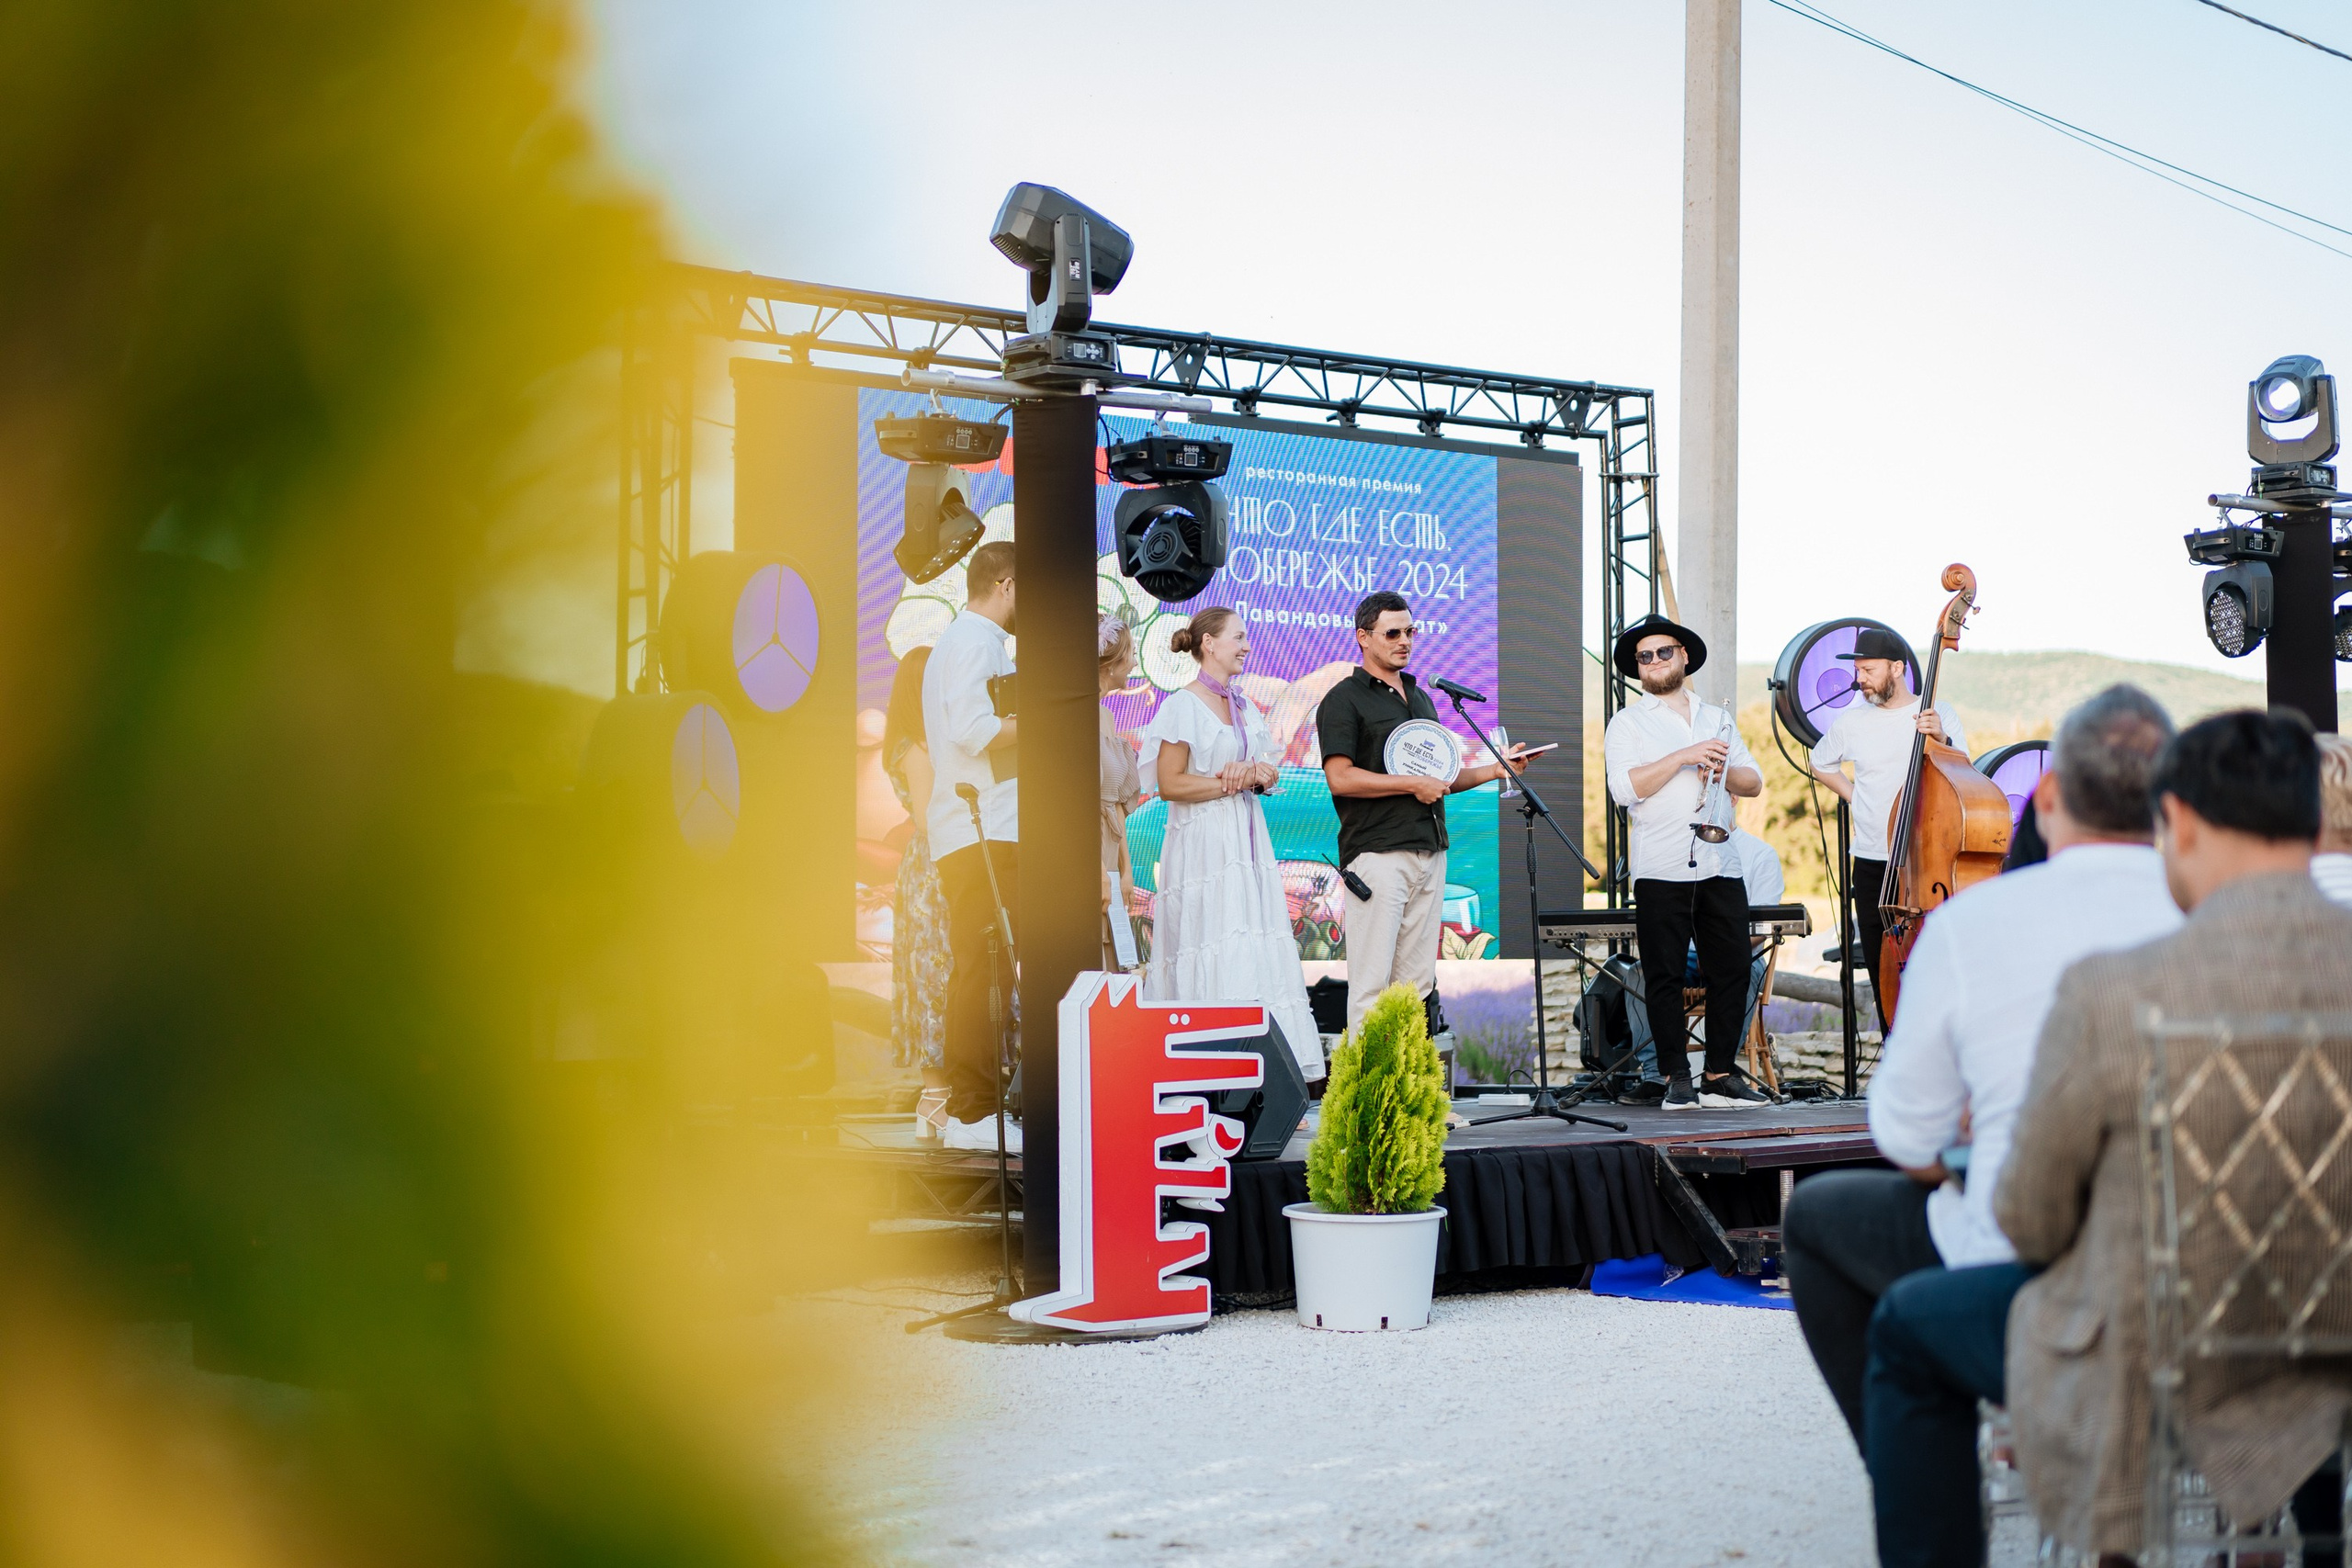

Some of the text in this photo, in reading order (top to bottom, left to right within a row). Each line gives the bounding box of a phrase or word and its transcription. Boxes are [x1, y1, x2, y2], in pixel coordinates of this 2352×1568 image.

[1246, 467, 1421, 494] ресторанная премия
[1312, 503, 1363, 544] ГДЕ
[1396, 560, 1468, 600] 2024
